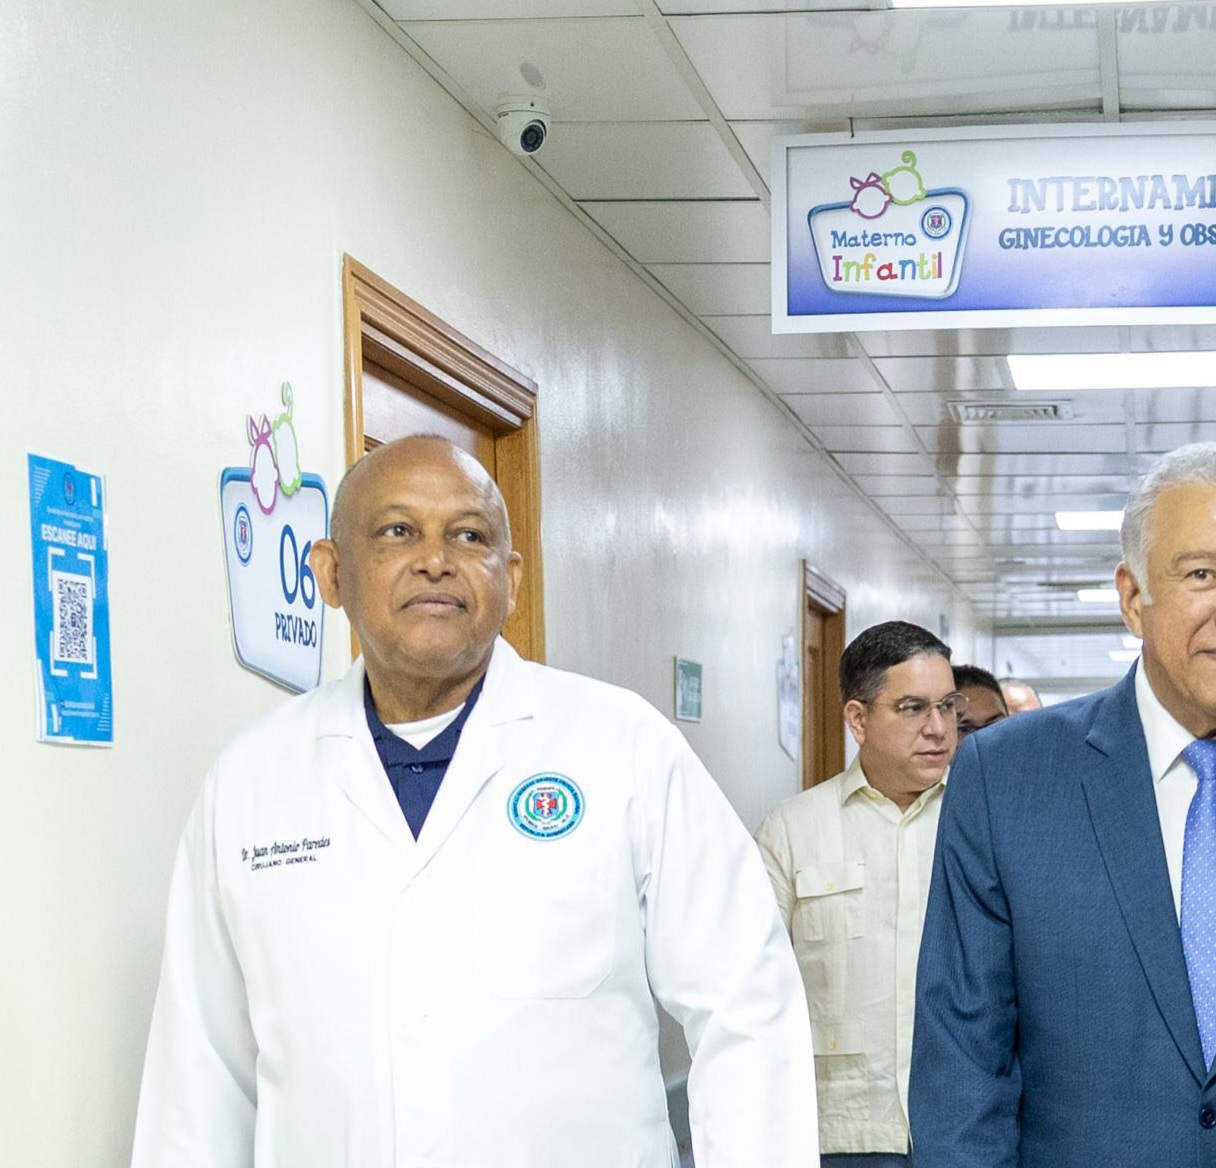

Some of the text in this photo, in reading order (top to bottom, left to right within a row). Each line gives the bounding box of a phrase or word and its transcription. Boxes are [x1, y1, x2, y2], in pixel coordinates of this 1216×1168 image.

[830, 229, 917, 248] Materno
[998, 224, 1152, 250] GINECOLOGIA
[832, 251, 942, 282] Infantil
[280, 524, 316, 610] 06
[275, 611, 317, 648] PRIVADO
[251, 845, 269, 862] Juan
[270, 841, 300, 857] Antonio
[302, 836, 331, 851] Paredes
[286, 854, 317, 866] GENERAL
